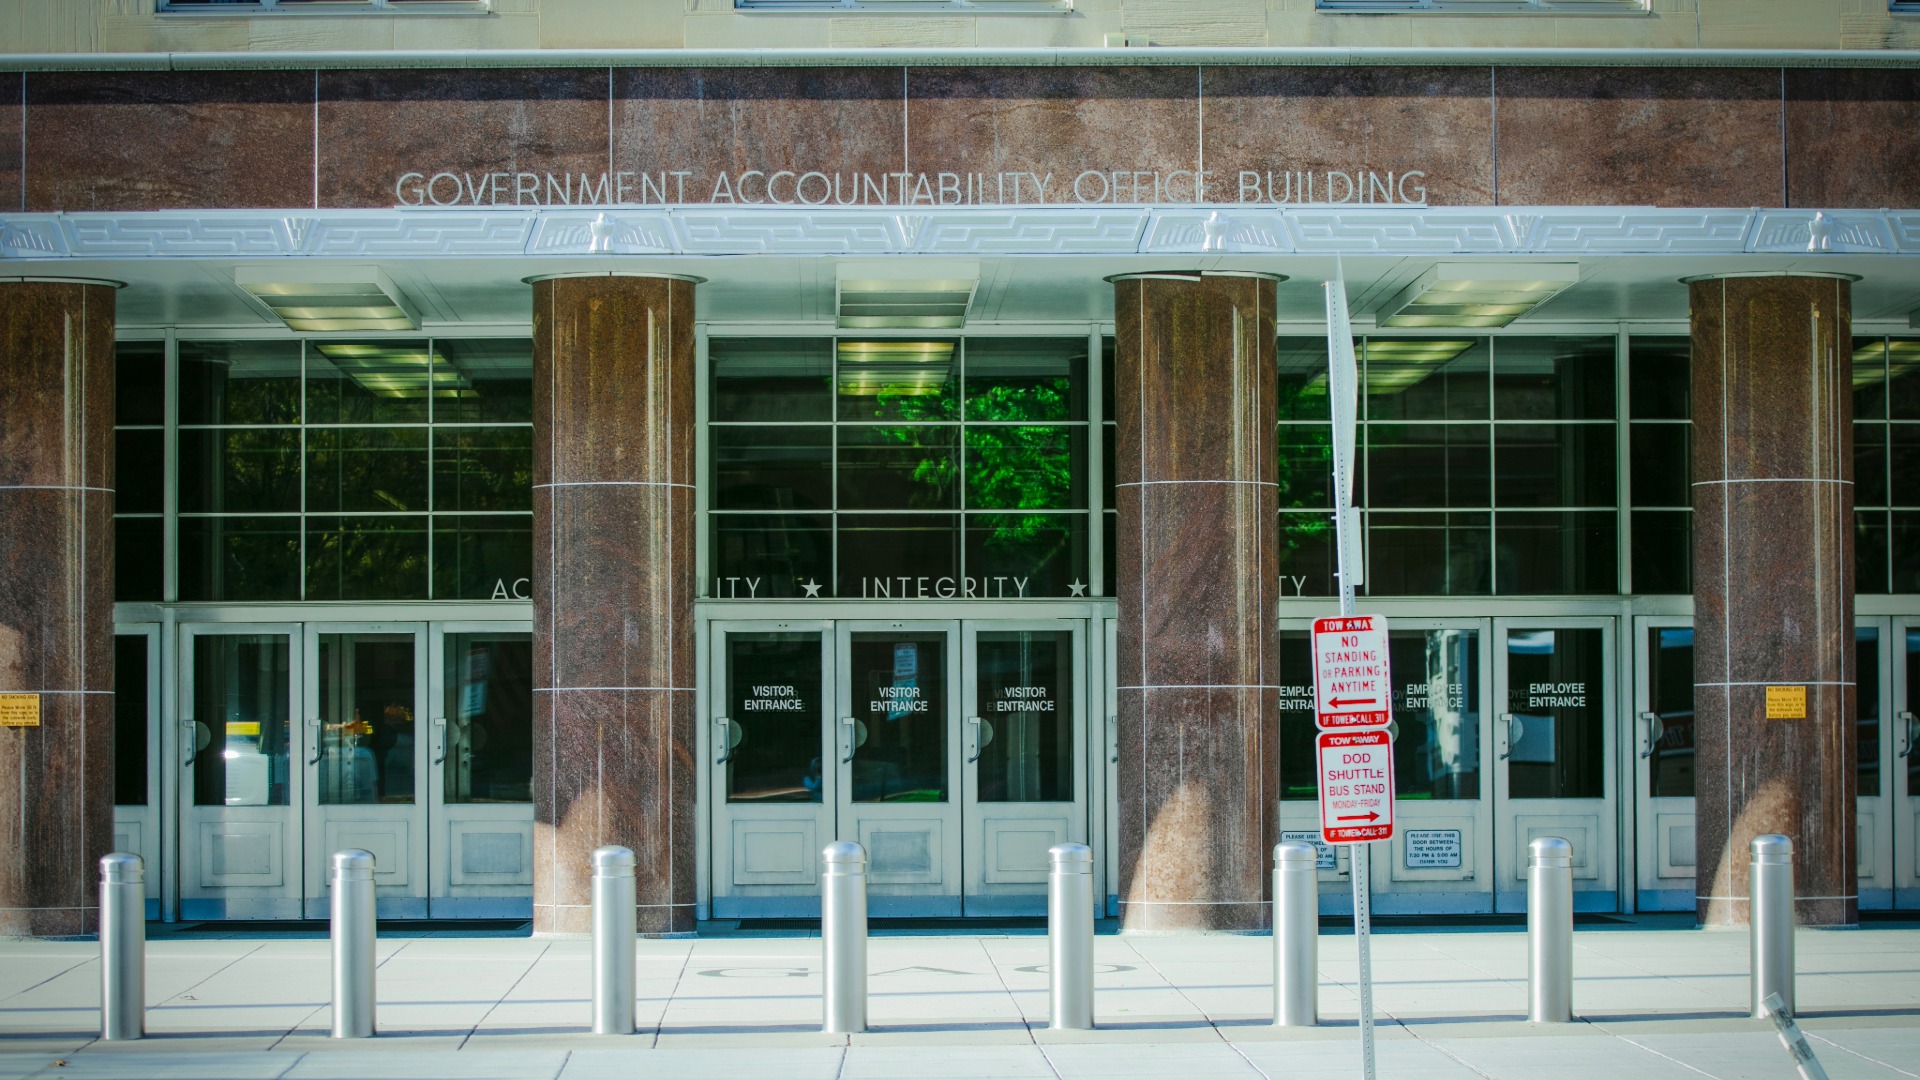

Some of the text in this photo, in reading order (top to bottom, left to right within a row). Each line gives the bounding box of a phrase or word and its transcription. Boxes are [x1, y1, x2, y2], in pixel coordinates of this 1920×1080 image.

[396, 170, 1428, 206] GOVERNMENT ACCOUNTABILITY OFFICE BUILDING
[862, 576, 1028, 598] INTEGRITY
[1323, 621, 1344, 631] TOW
[1341, 636, 1358, 648] NO
[1325, 650, 1376, 664] STANDING
[1323, 666, 1380, 678] OR PARKING
[752, 686, 794, 696] VISITOR
[1280, 686, 1314, 696] EMPLO
[1331, 680, 1376, 693] ANYTIME
[1406, 684, 1462, 694] EMPOYEE
[1530, 683, 1585, 694] EMPLOYEE
[878, 687, 920, 698] VISITOR
[1004, 687, 1046, 698] VISITOR
[744, 700, 802, 710] ENTRANCE
[870, 700, 928, 712] ENTRANCE
[997, 700, 1054, 712] ENTRANCE
[1280, 700, 1315, 710] ENTRA
[1530, 696, 1586, 707] ENTRANCE
[1323, 716, 1330, 725] IF
[1375, 713, 1384, 722] 311
[1328, 735, 1380, 746] TOW AWAY
[1342, 753, 1370, 764] DOD
[1328, 768, 1384, 780] SHUTTLE
[1329, 784, 1385, 796] BUS STAND
